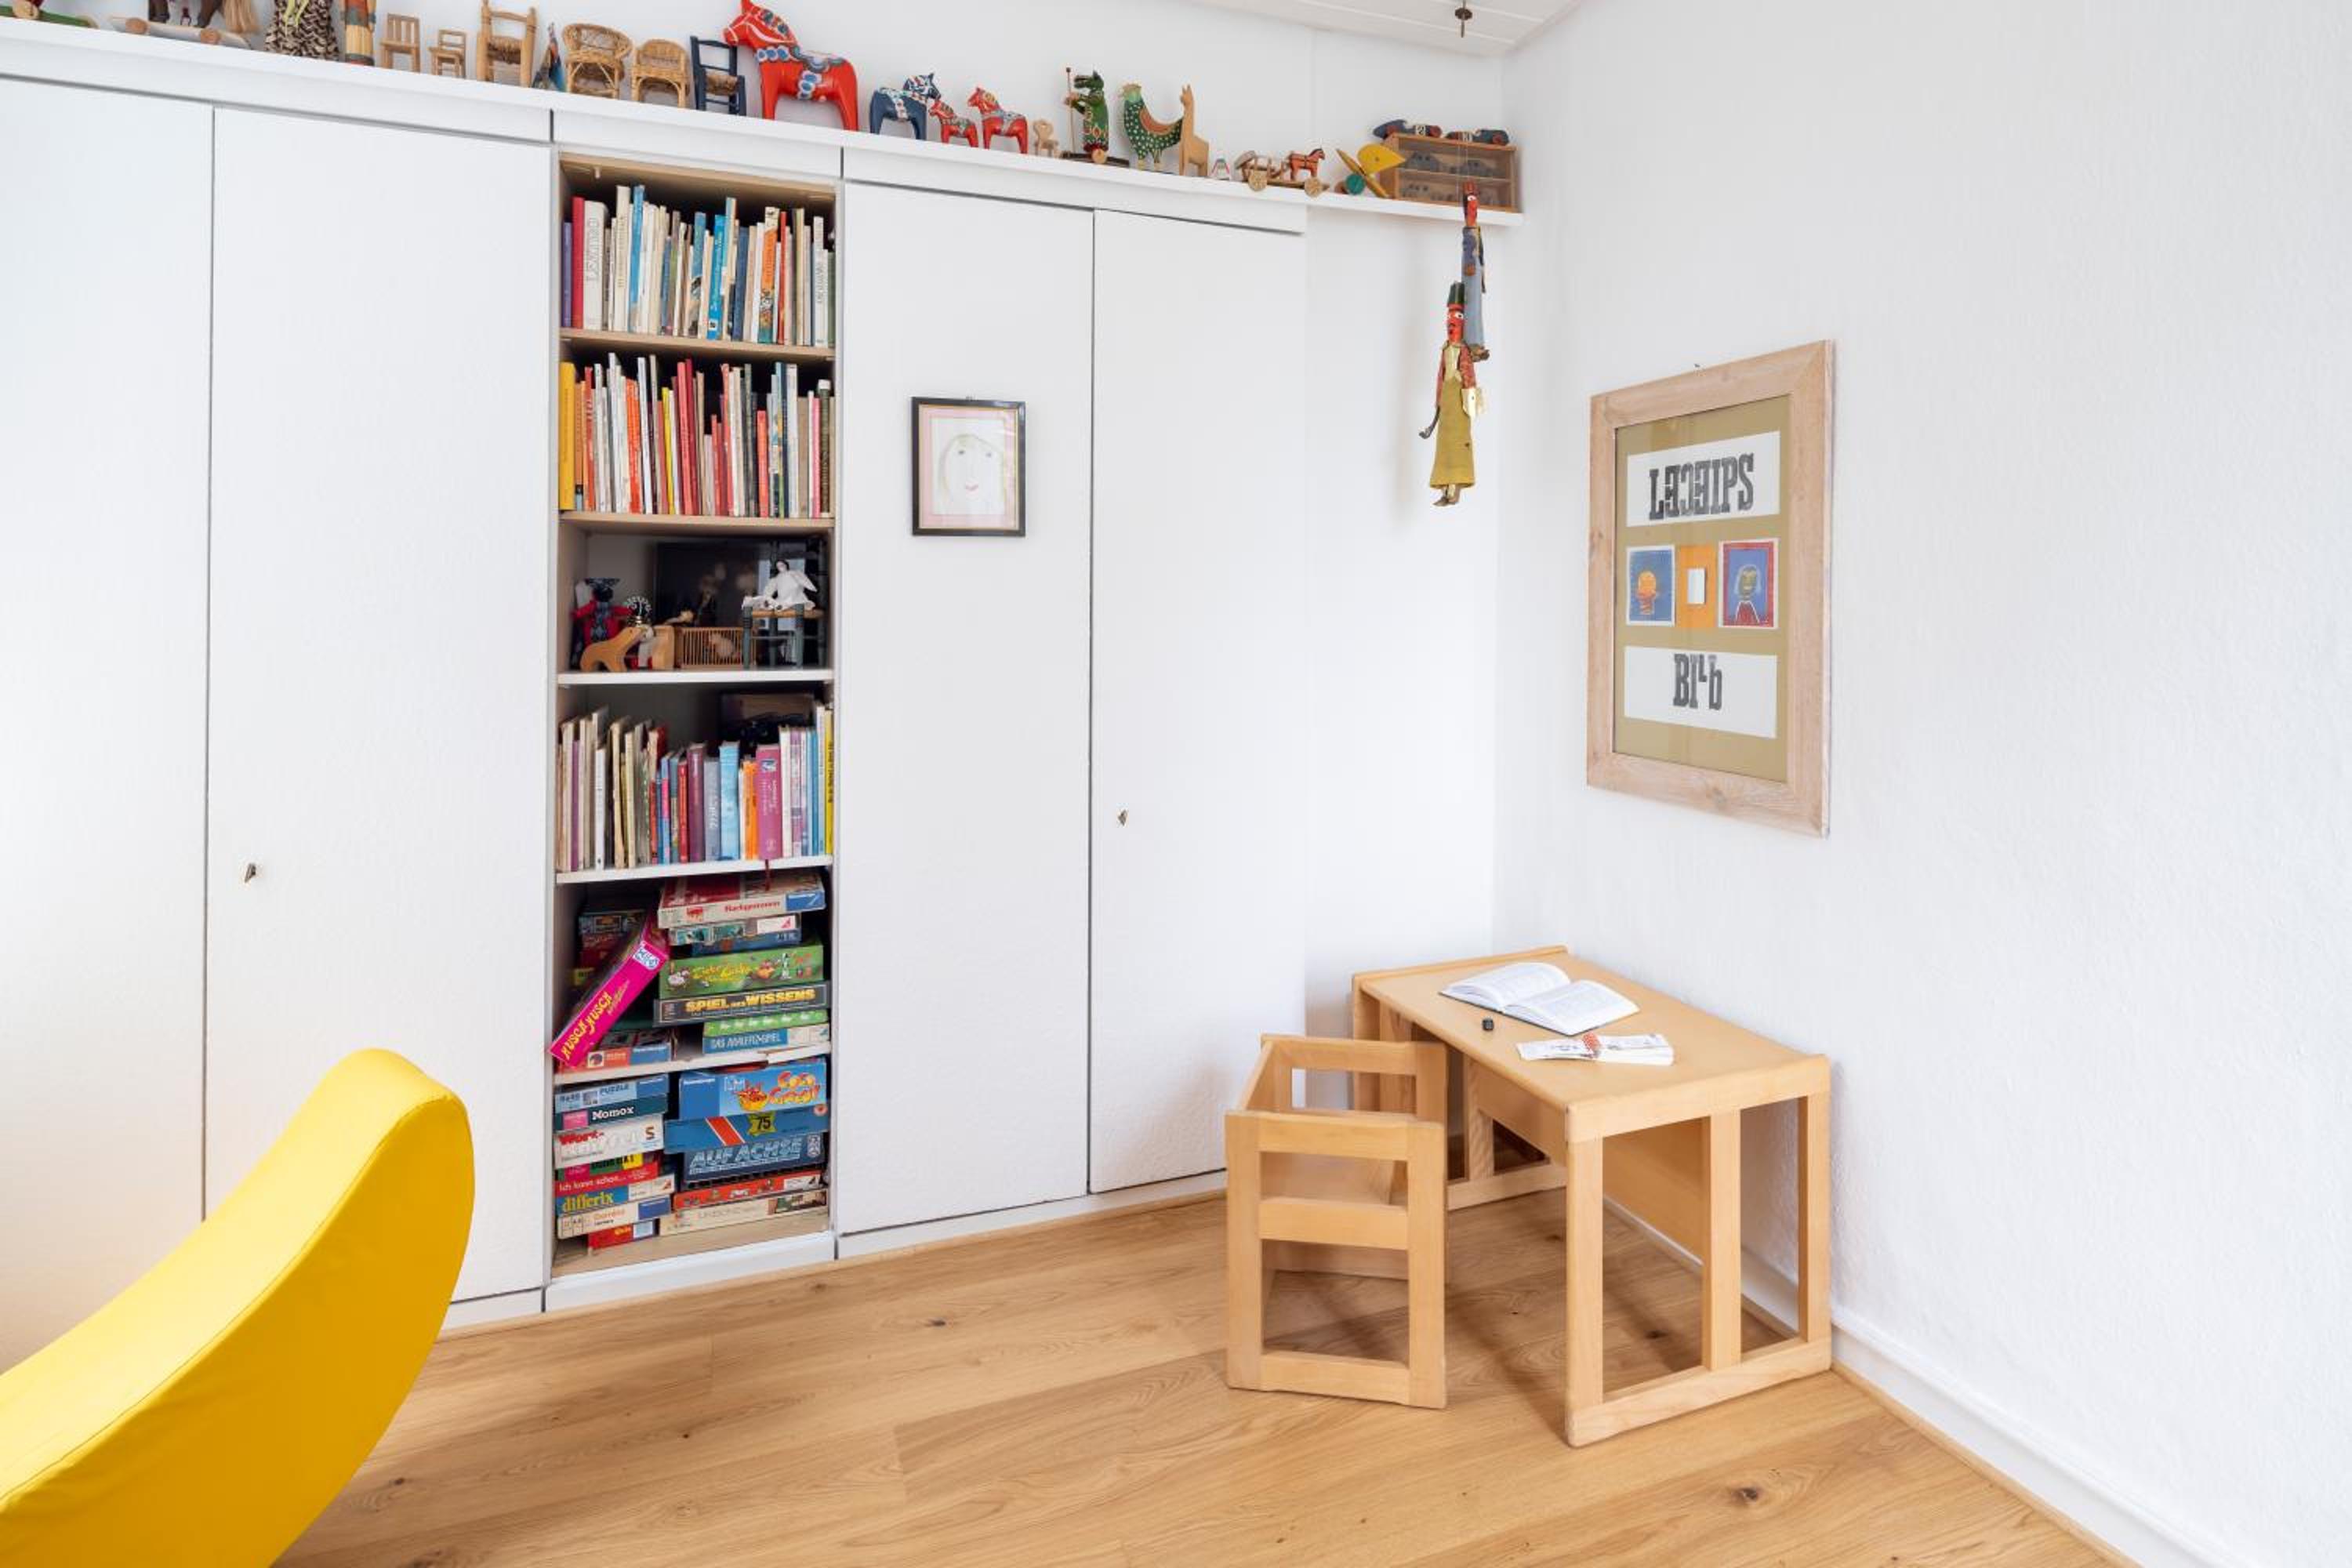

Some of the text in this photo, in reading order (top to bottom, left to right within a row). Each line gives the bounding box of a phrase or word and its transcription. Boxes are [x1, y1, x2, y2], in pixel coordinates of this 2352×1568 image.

[685, 997, 728, 1012] SPIEL
[745, 989, 816, 1007] WISSENS
[757, 1116, 771, 1130] 75
[689, 1147, 735, 1168] AUF
[735, 1138, 803, 1162] ACHSE
